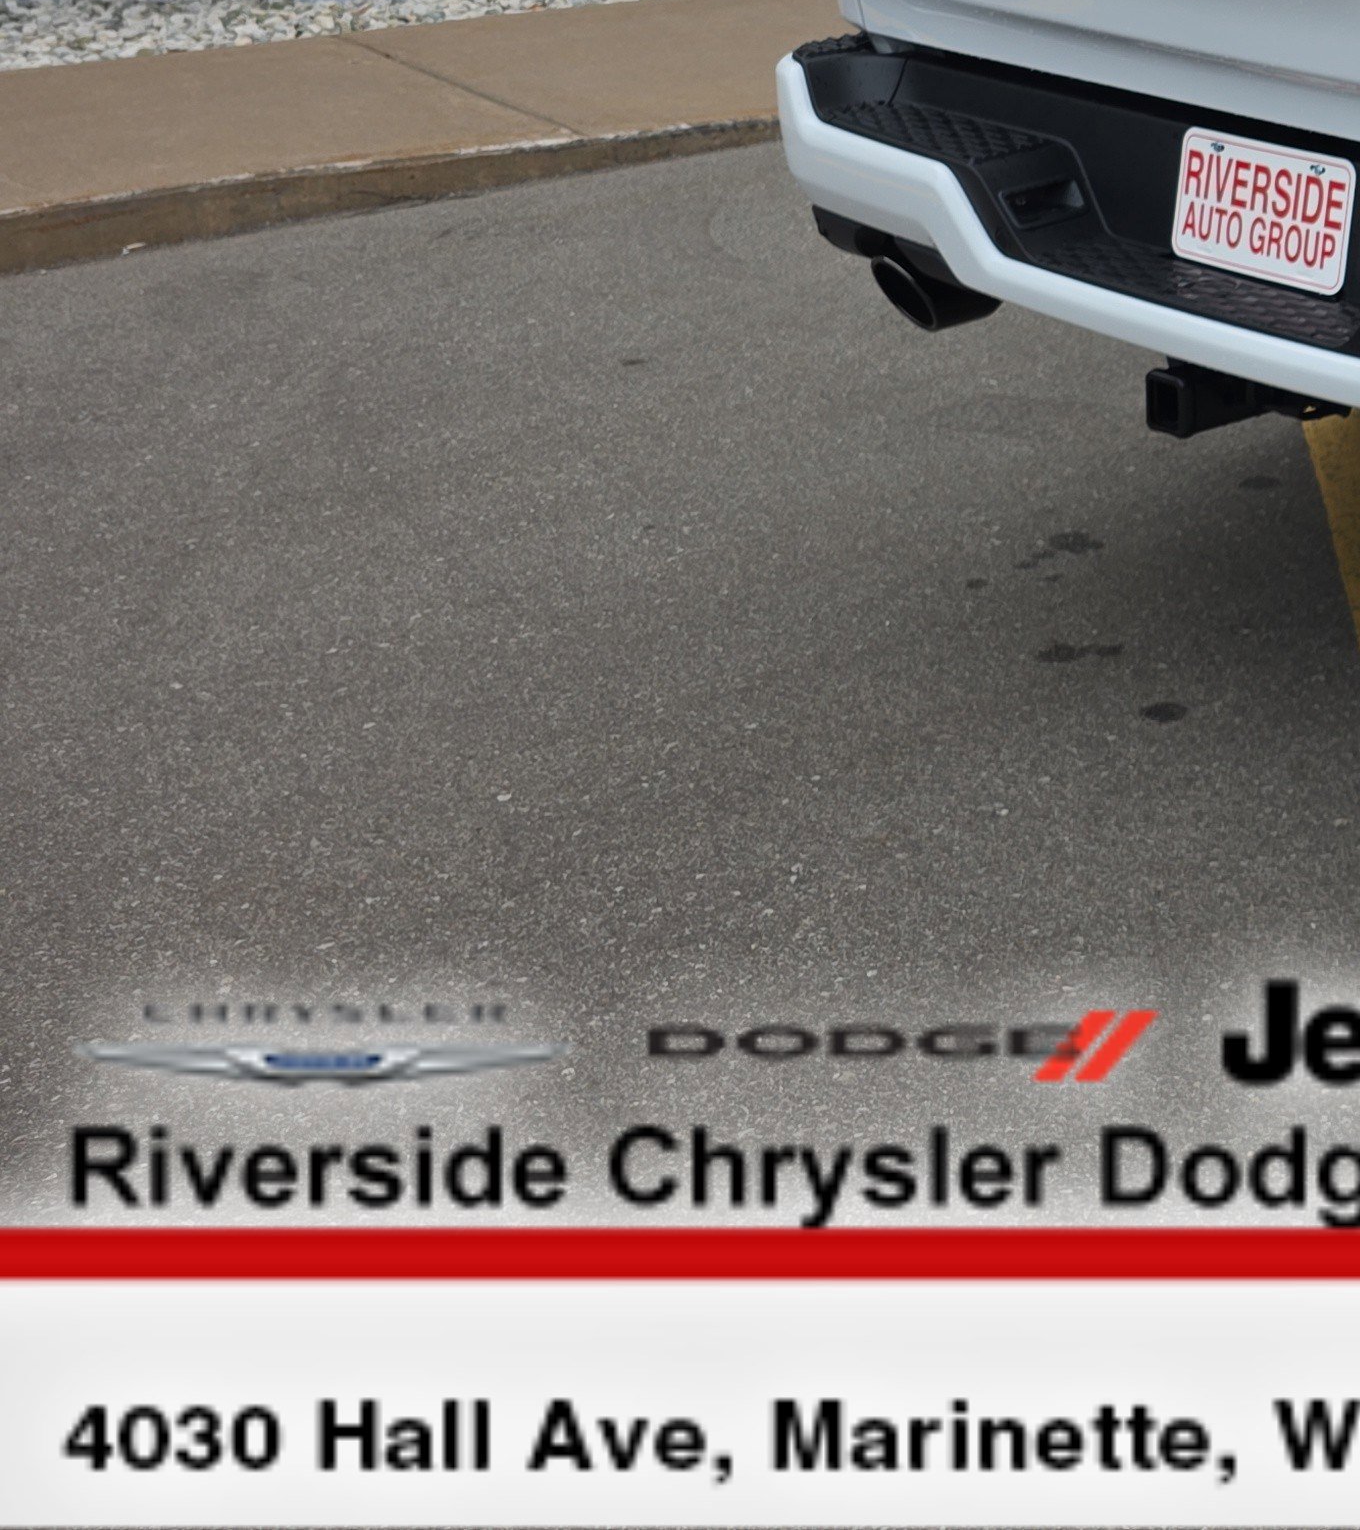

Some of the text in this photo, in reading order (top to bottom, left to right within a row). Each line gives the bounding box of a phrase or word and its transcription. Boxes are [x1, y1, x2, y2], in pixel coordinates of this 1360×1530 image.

[1184, 149, 1347, 231] RIVERSIDE
[1181, 201, 1336, 270] AUTO GROUP
